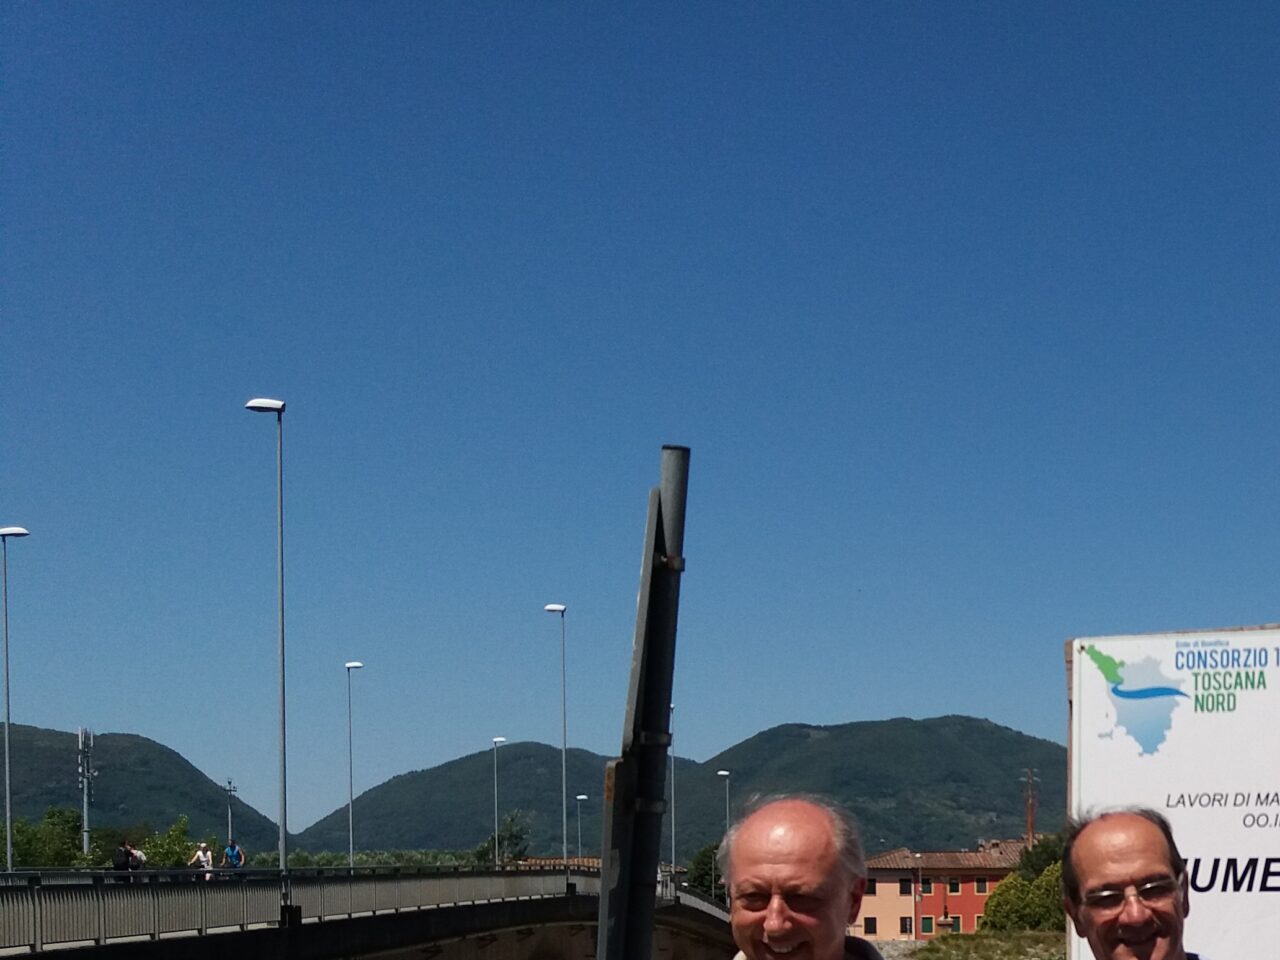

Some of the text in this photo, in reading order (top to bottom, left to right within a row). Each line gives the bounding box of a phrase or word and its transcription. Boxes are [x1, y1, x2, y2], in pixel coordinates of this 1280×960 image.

[1175, 647, 1280, 670] CONSORZIO 1
[1192, 670, 1267, 691] TOSCANA
[1194, 692, 1237, 713] NORD
[1166, 793, 1228, 808] LAVORI
[1233, 793, 1250, 807] DI
